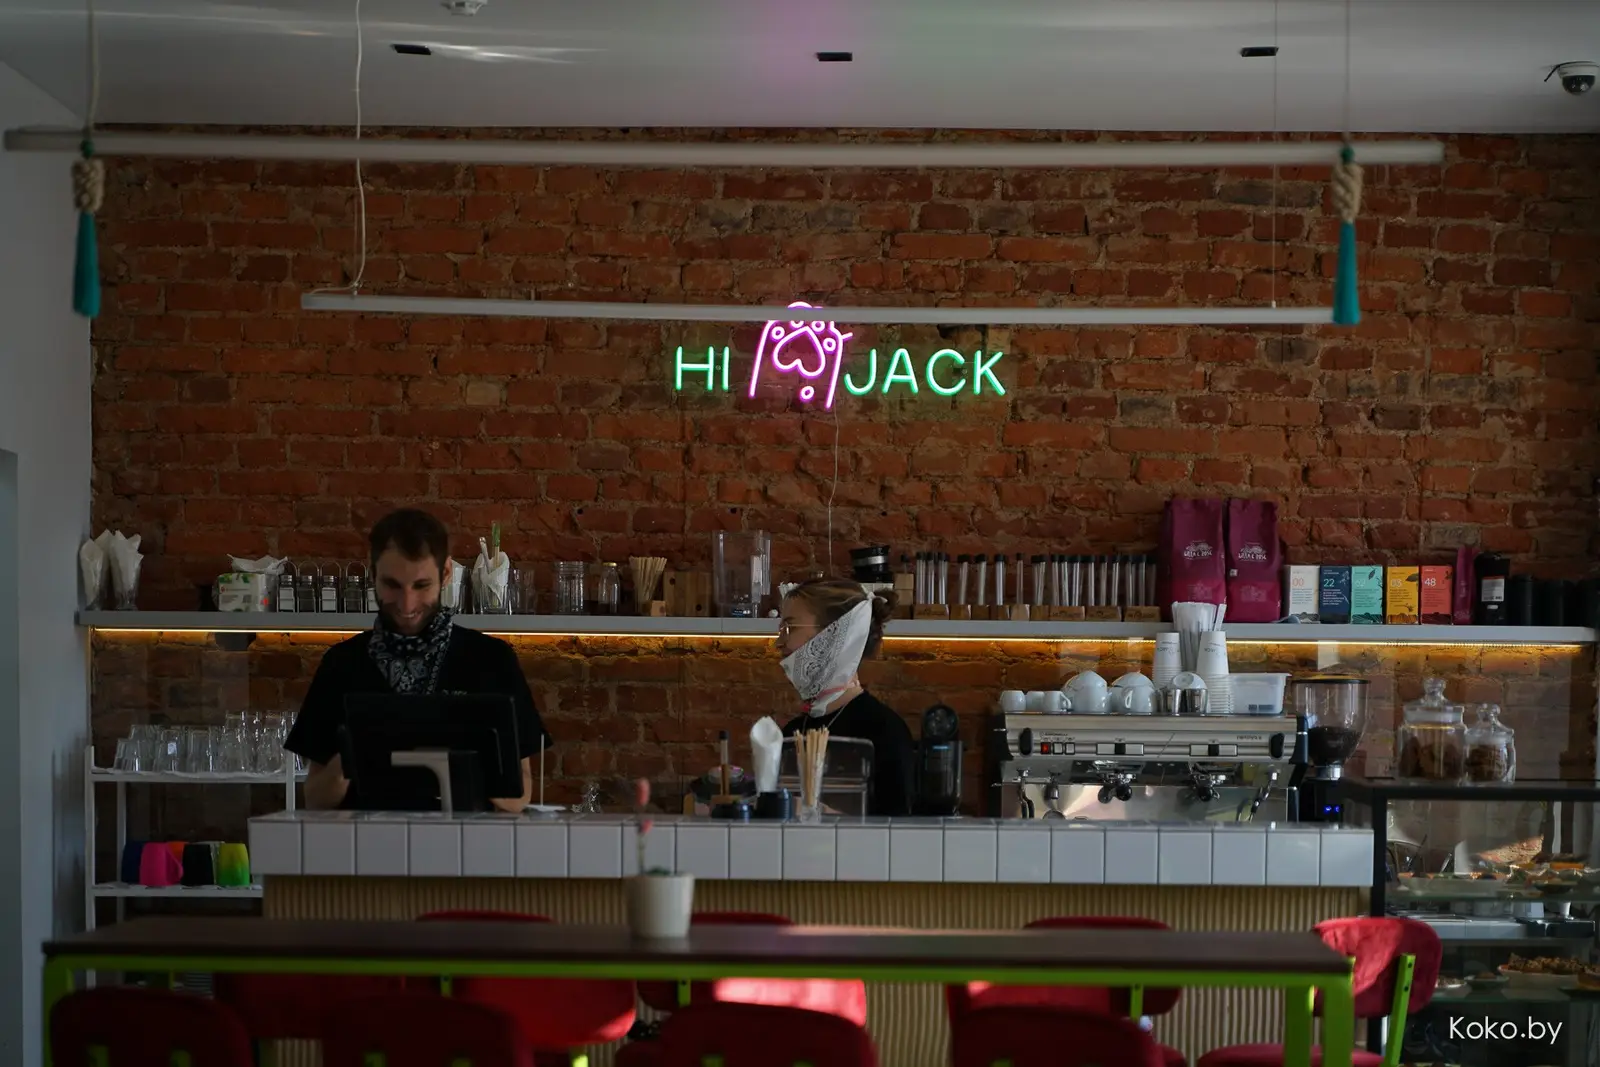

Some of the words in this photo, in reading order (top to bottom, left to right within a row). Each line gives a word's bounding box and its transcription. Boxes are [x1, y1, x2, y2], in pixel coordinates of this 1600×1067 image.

[675, 345, 730, 392] HI
[843, 347, 1006, 397] JACK
[1323, 578, 1335, 588] 22
[1424, 577, 1437, 588] 48
